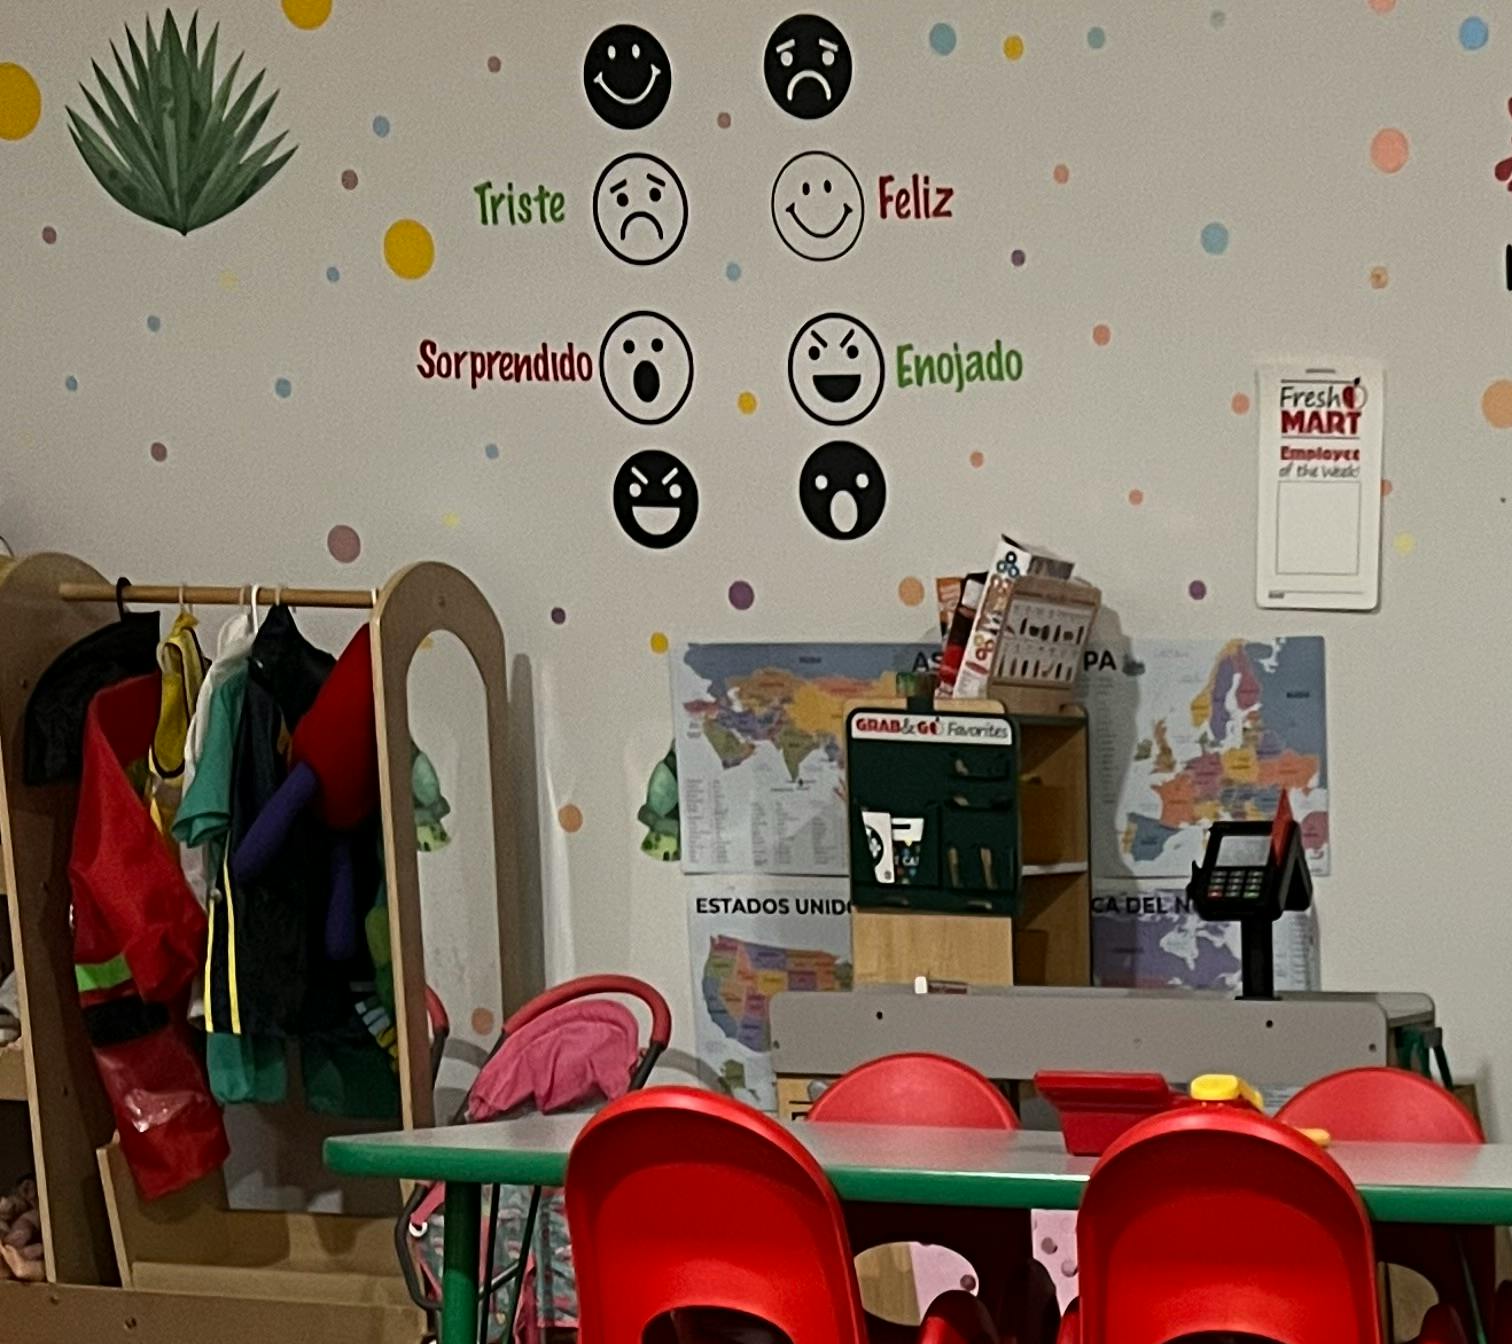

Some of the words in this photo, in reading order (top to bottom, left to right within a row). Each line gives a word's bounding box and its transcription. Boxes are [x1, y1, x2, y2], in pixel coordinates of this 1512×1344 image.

[473, 181, 567, 226] Triste
[878, 174, 955, 220] Feliz
[416, 339, 594, 389] Sorprendido
[896, 339, 1024, 393] Enojado
[1280, 385, 1341, 408] Fresh
[1280, 411, 1362, 435] MART
[1280, 446, 1361, 462] Employee
[1296, 463, 1318, 478] the
[947, 721, 1009, 740] Favorites
[695, 896, 791, 916] ESTADOS
[795, 897, 854, 916] UNID
[1126, 896, 1168, 914] DEL
